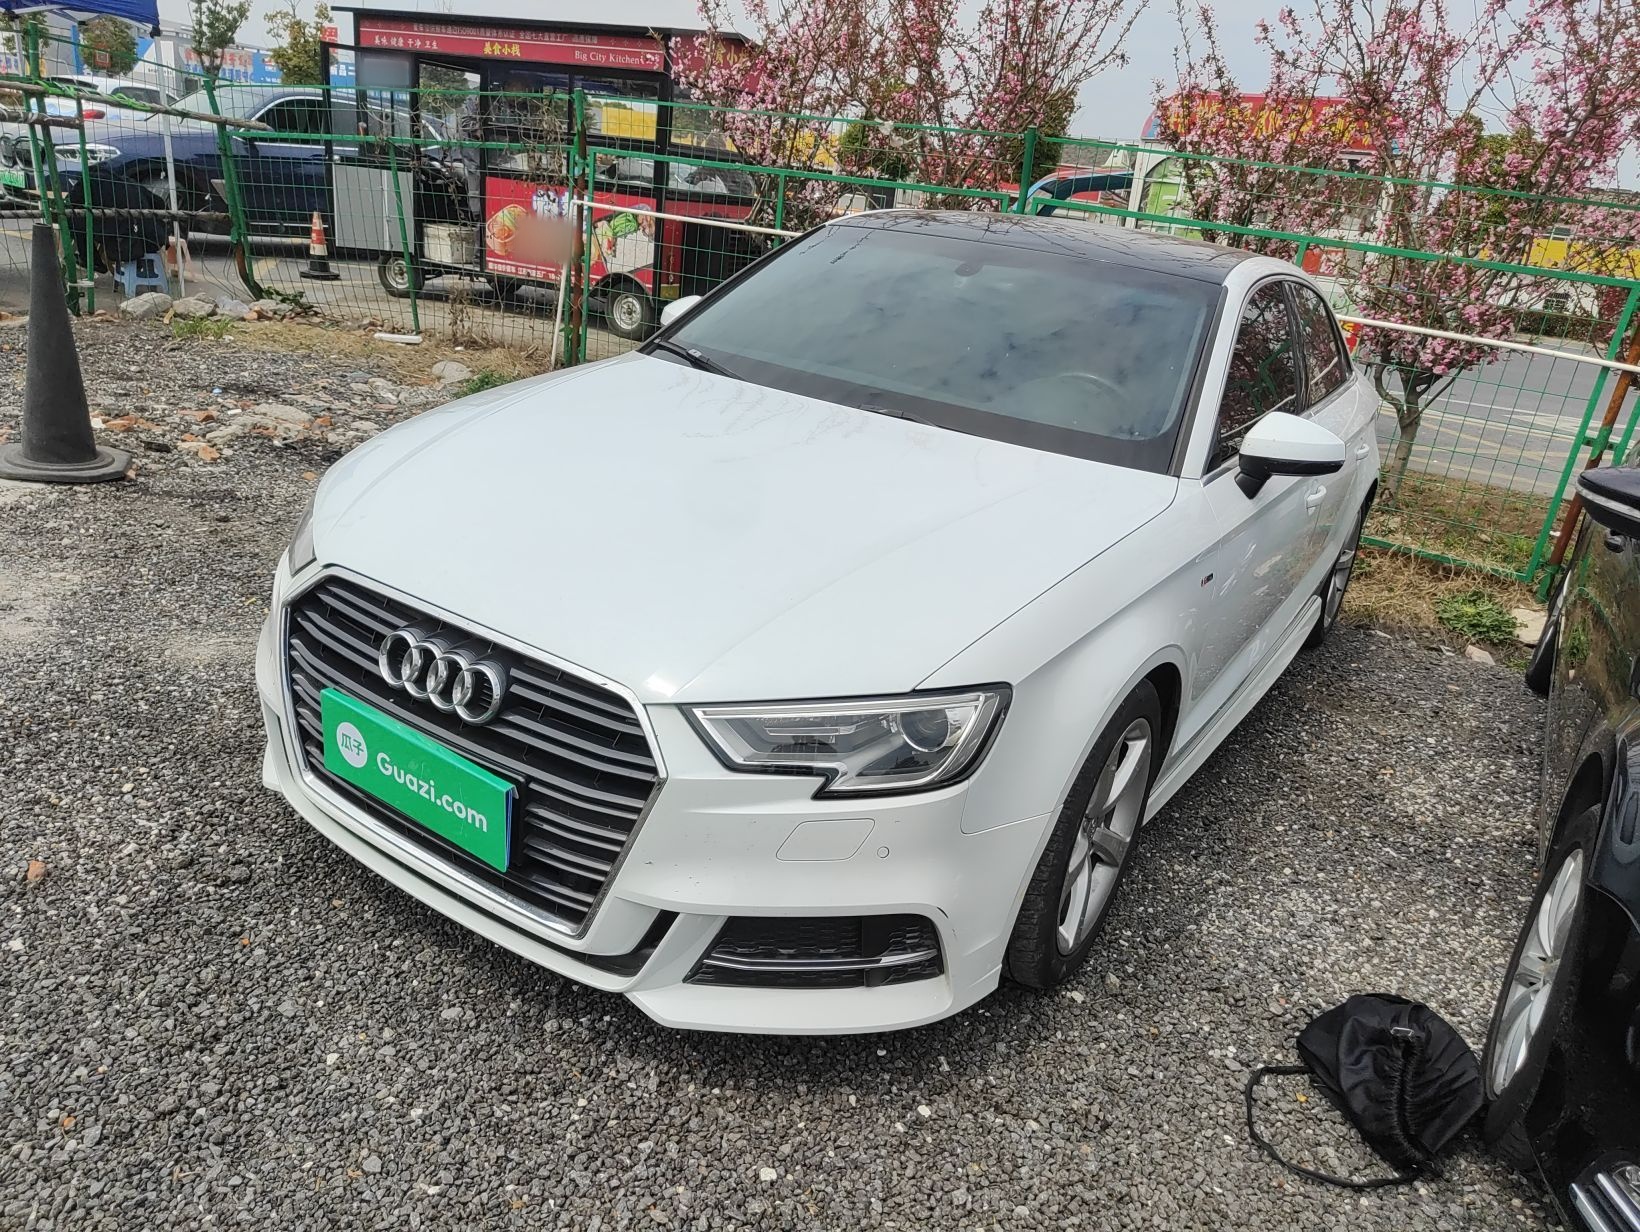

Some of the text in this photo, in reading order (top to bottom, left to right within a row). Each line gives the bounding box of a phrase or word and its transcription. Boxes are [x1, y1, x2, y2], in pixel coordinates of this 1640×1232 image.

[374, 35, 438, 49] 美味 健康 干净 卫生
[483, 41, 521, 57] 美食小栈
[574, 50, 640, 65] Big City Kitchen
[340, 731, 365, 756] 瓜子
[376, 752, 488, 833] Guazi.com
